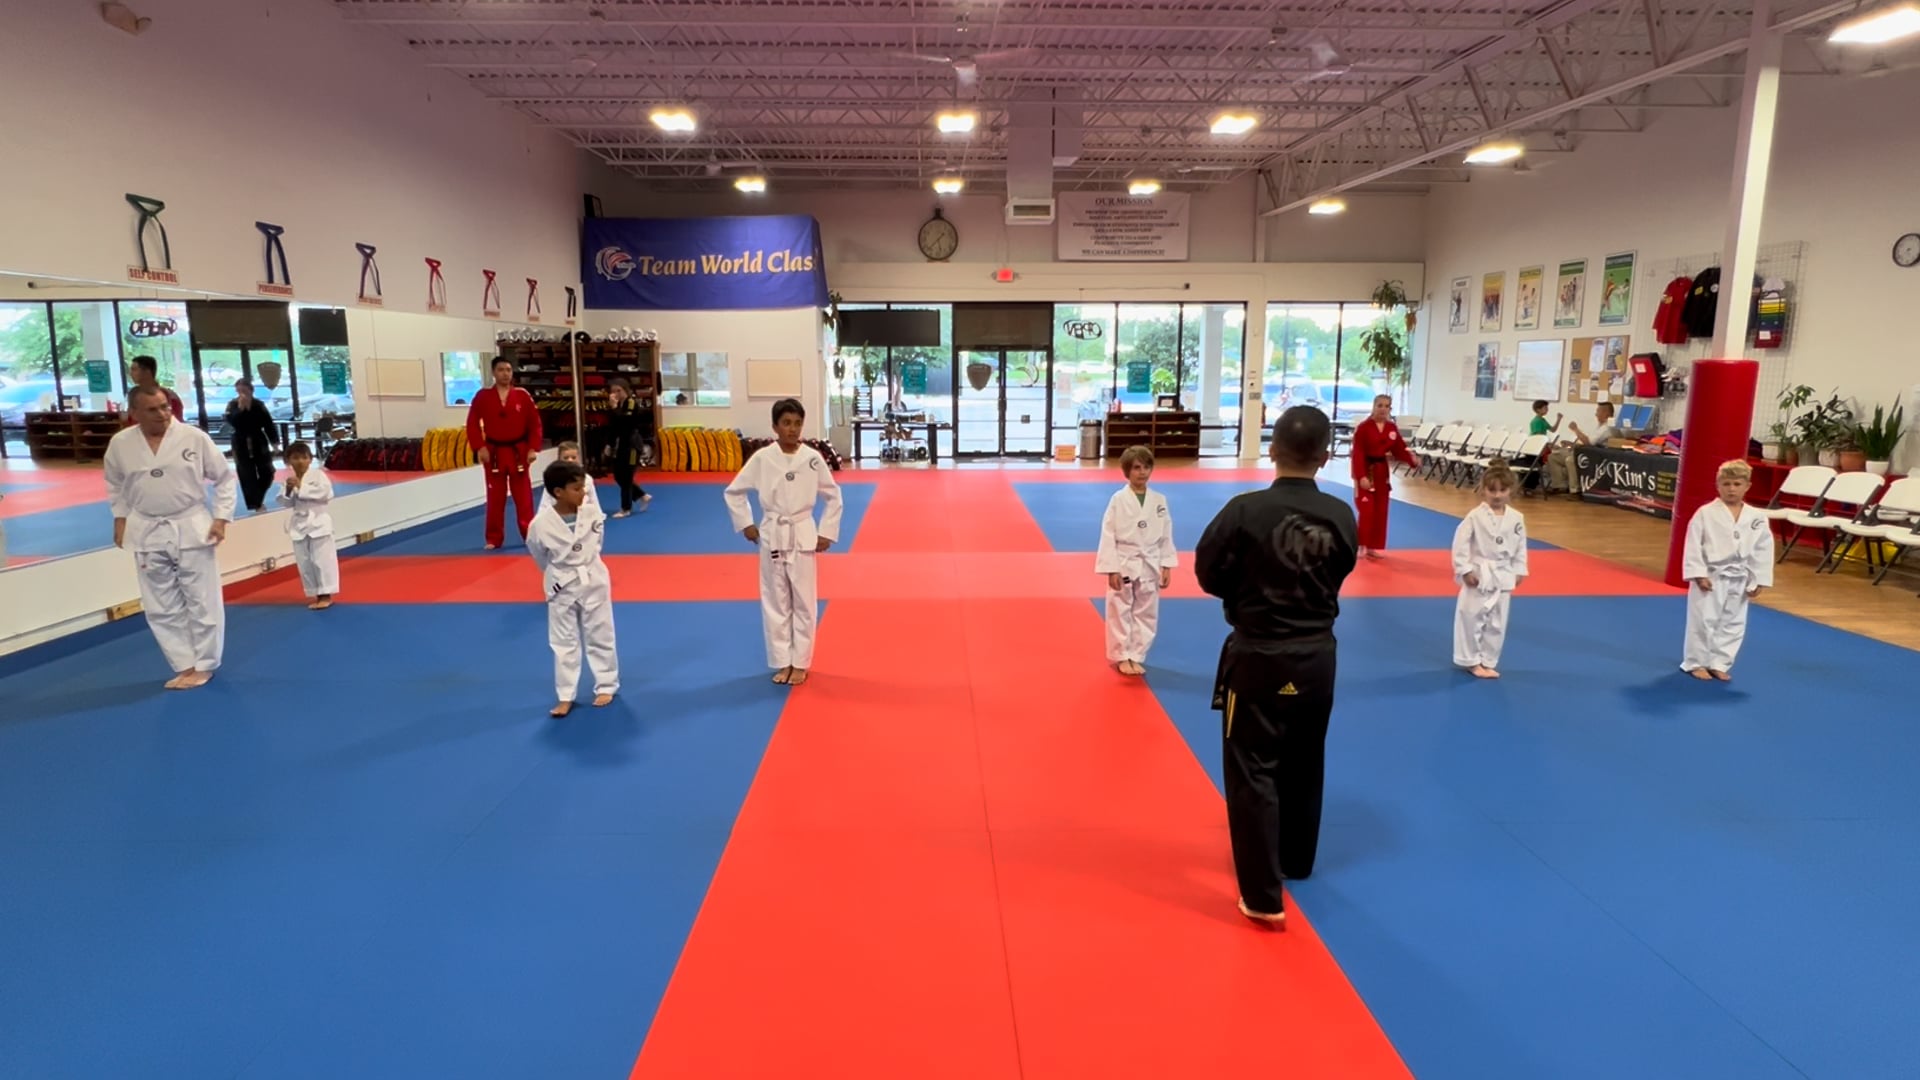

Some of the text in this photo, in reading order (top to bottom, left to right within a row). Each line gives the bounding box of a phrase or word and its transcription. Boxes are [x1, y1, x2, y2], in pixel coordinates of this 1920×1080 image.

[639, 249, 815, 276] Team World Clas
[147, 270, 177, 283] CONTROL
[130, 318, 177, 337] OPEN
[1606, 462, 1656, 491] Kim's
